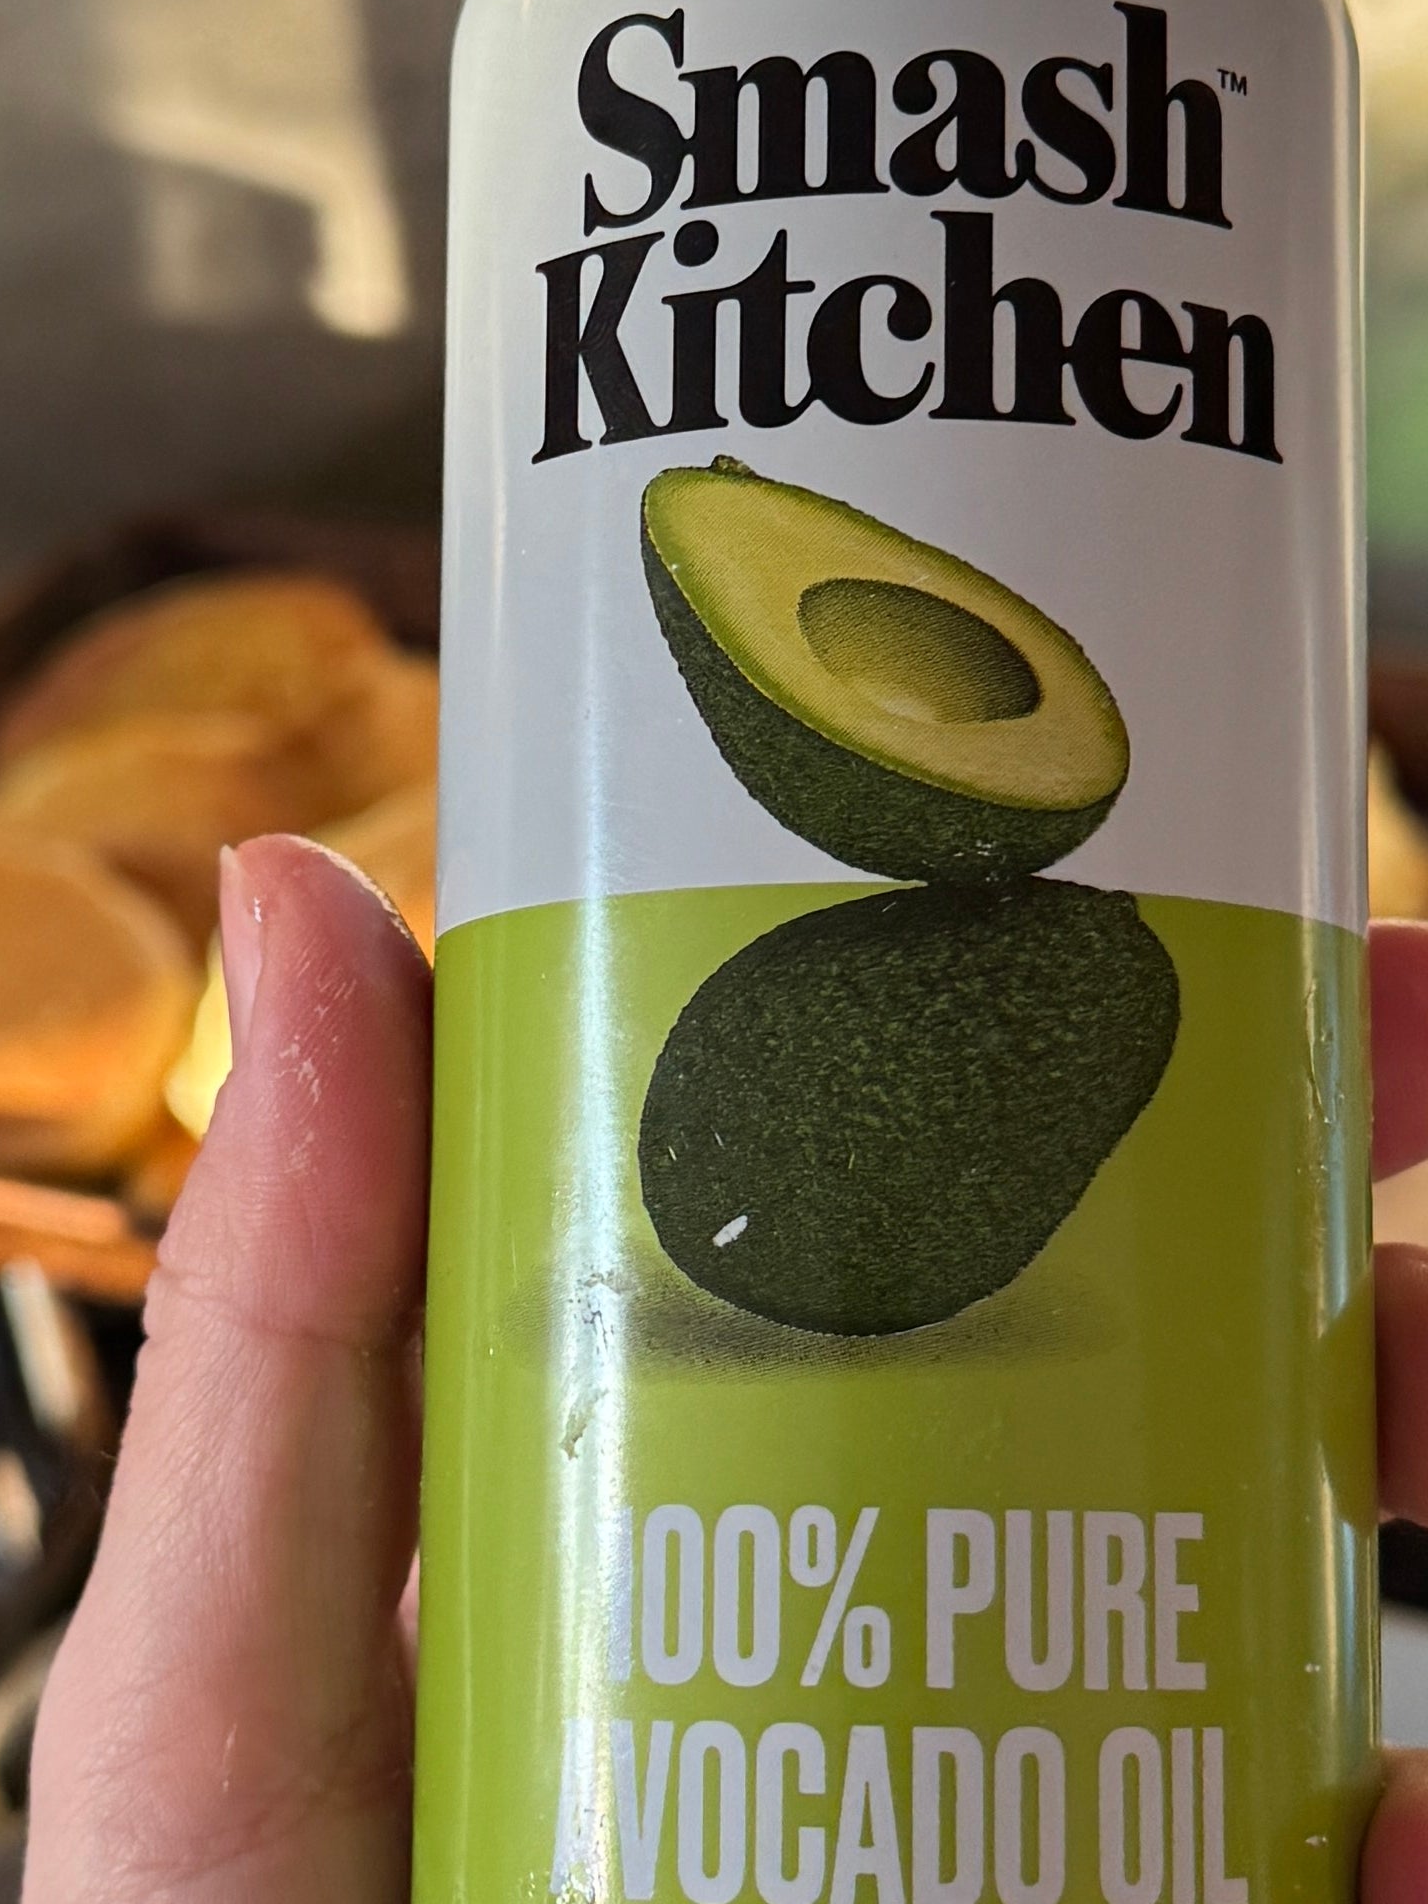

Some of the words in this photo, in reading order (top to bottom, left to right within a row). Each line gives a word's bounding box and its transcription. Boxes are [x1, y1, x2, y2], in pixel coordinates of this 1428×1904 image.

[577, 1, 1233, 236] Smash
[531, 210, 1284, 466] Kitchen
[599, 1504, 892, 1688] 100%
[925, 1507, 1207, 1692] PURE
